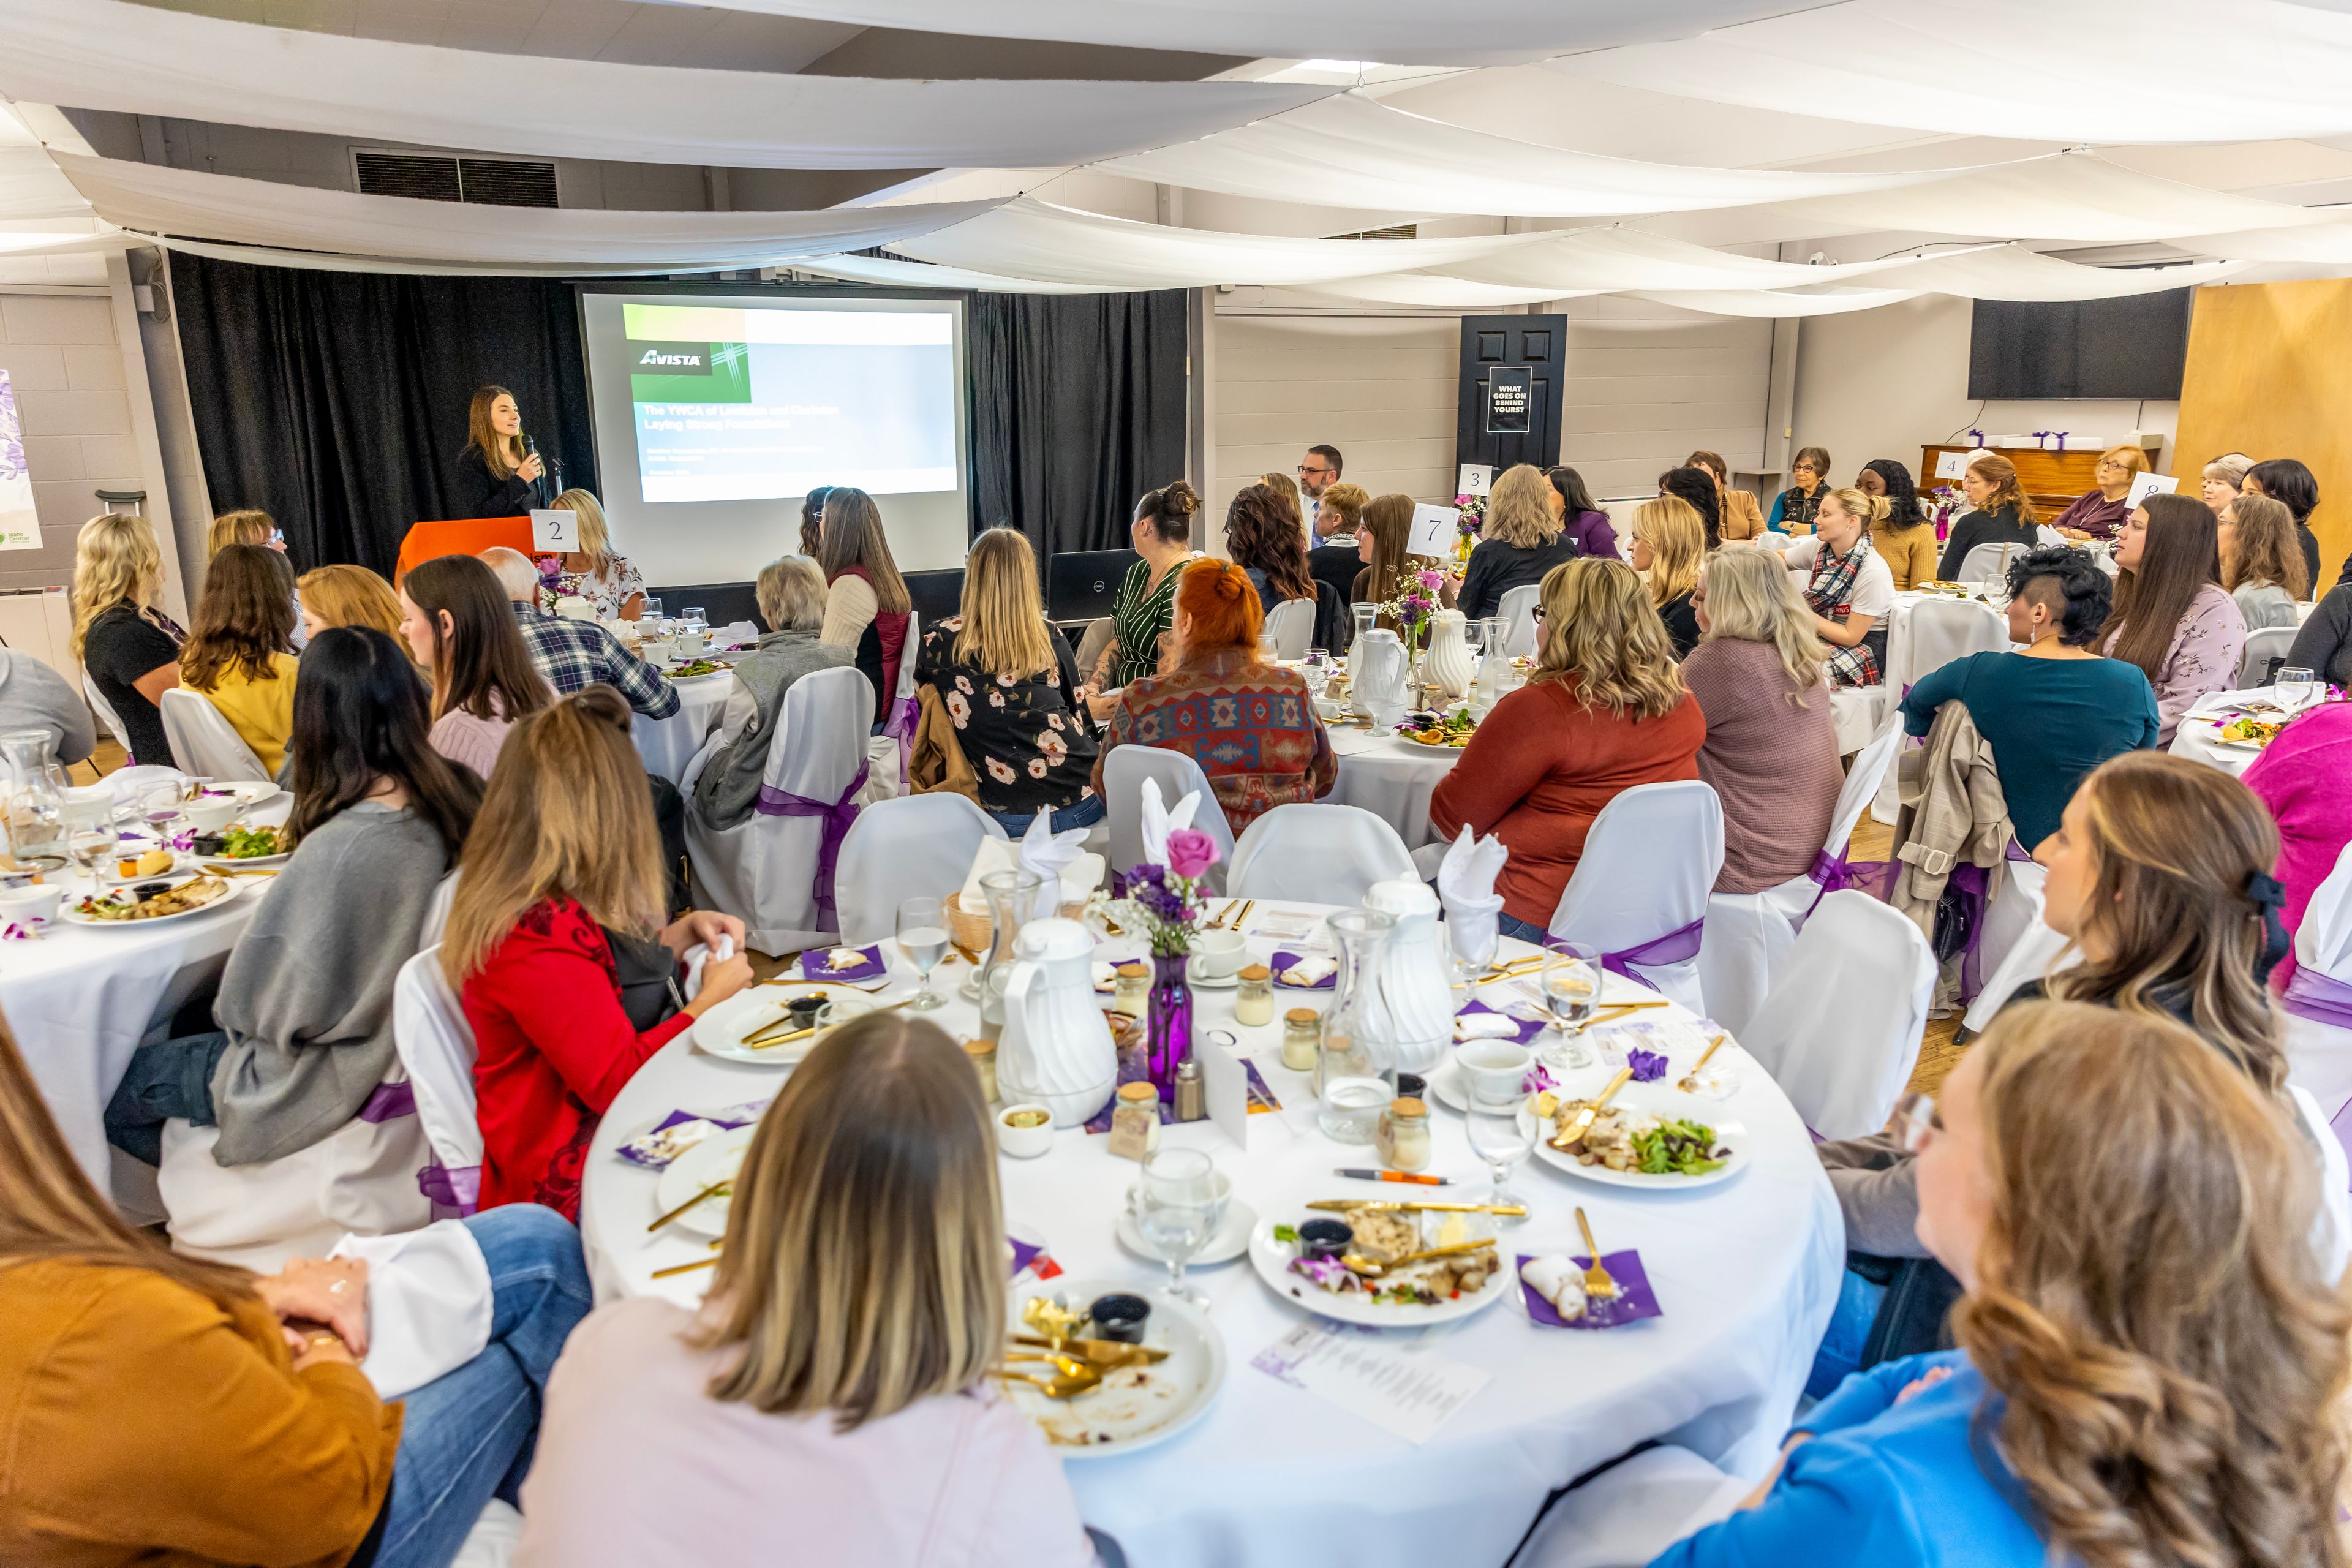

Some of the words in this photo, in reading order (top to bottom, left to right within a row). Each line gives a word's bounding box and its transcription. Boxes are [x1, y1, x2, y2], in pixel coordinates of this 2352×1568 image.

[639, 350, 701, 366] AVISTA
[643, 405, 665, 415] The
[666, 405, 704, 416] YWCA
[644, 418, 684, 432] Laying
[1947, 460, 1957, 472] 4
[1470, 473, 1480, 486] 3
[549, 522, 563, 540] 2
[1428, 519, 1442, 541] 7
